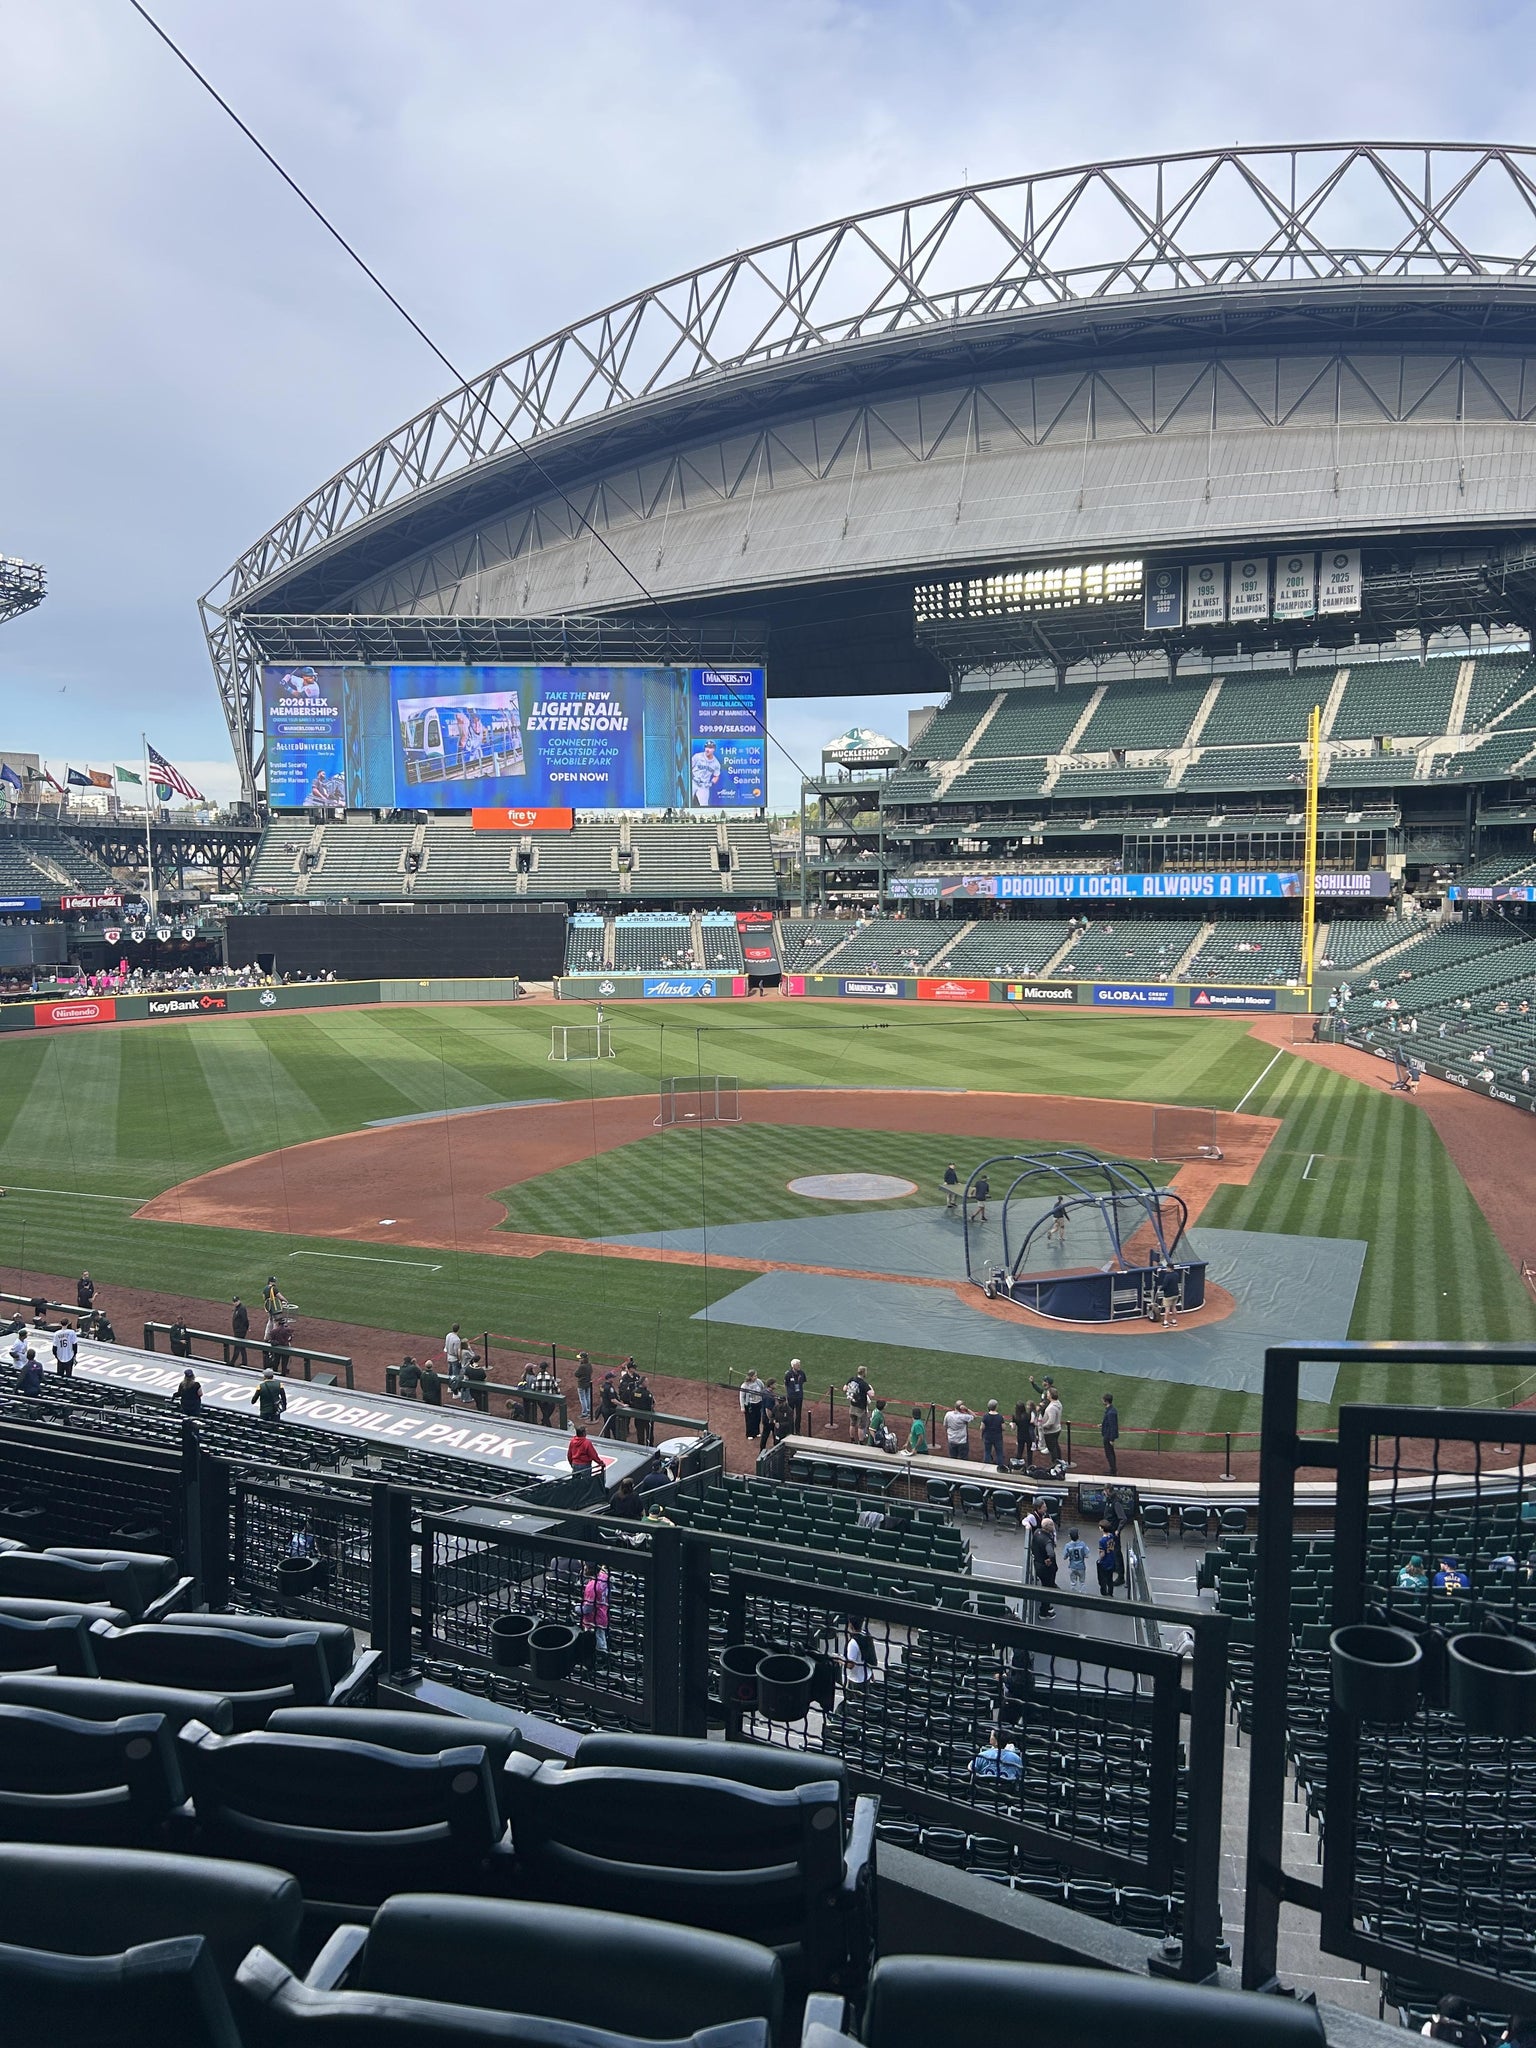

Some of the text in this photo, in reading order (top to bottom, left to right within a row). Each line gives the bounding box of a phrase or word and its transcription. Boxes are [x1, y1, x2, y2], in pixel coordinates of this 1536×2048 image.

[1286, 576, 1304, 587] 2001
[1331, 573, 1350, 583] 2025
[1197, 585, 1215, 596] 1995
[1241, 581, 1258, 592] 1997
[1338, 585, 1354, 594] WEST
[1246, 593, 1263, 602] WEST
[1292, 589, 1309, 598] WEST
[1204, 597, 1219, 606] WEST
[1277, 600, 1312, 611] CHAMPIONS
[1322, 596, 1357, 607] CHAMPIONS
[1189, 608, 1223, 619] CHAMPIONS
[1232, 604, 1266, 615] CHAMPIONS
[545, 692, 611, 700] TAKE THE NEW
[279, 698, 328, 706] 2026 FLEX
[270, 707, 338, 716] MEMBERSHIPS
[532, 702, 622, 716] LIGHT RAIL
[527, 717, 629, 731] EXTENSION!
[699, 725, 756, 733] $99.99/SEASON
[548, 738, 608, 747] CONNECTING
[538, 748, 619, 756] THE EASTSIDE AND
[831, 748, 890, 758] MUCKLESHOOT
[546, 757, 612, 765] T-MOBILE PARK
[723, 757, 748, 765] Points
[549, 773, 609, 781] OPEN NOW!
[507, 810, 536, 819] fire tv
[1002, 876, 1272, 896] PROUDLY LOCAL. ALWAYS A HIT.
[1315, 874, 1371, 889] SCHILLING
[647, 981, 693, 996] Alaska
[1024, 987, 1073, 1000] Microsoft
[1098, 990, 1147, 1001] GLOBAL
[1210, 995, 1272, 1005] Benjamin Moore
[149, 999, 199, 1013] KeyBank
[56, 1009, 96, 1018] Nintendo
[1496, 1090, 1516, 1103] LEXUS
[60, 1339, 68, 1348] 16
[207, 1381, 257, 1402] TO
[412, 1423, 535, 1459] PARK
